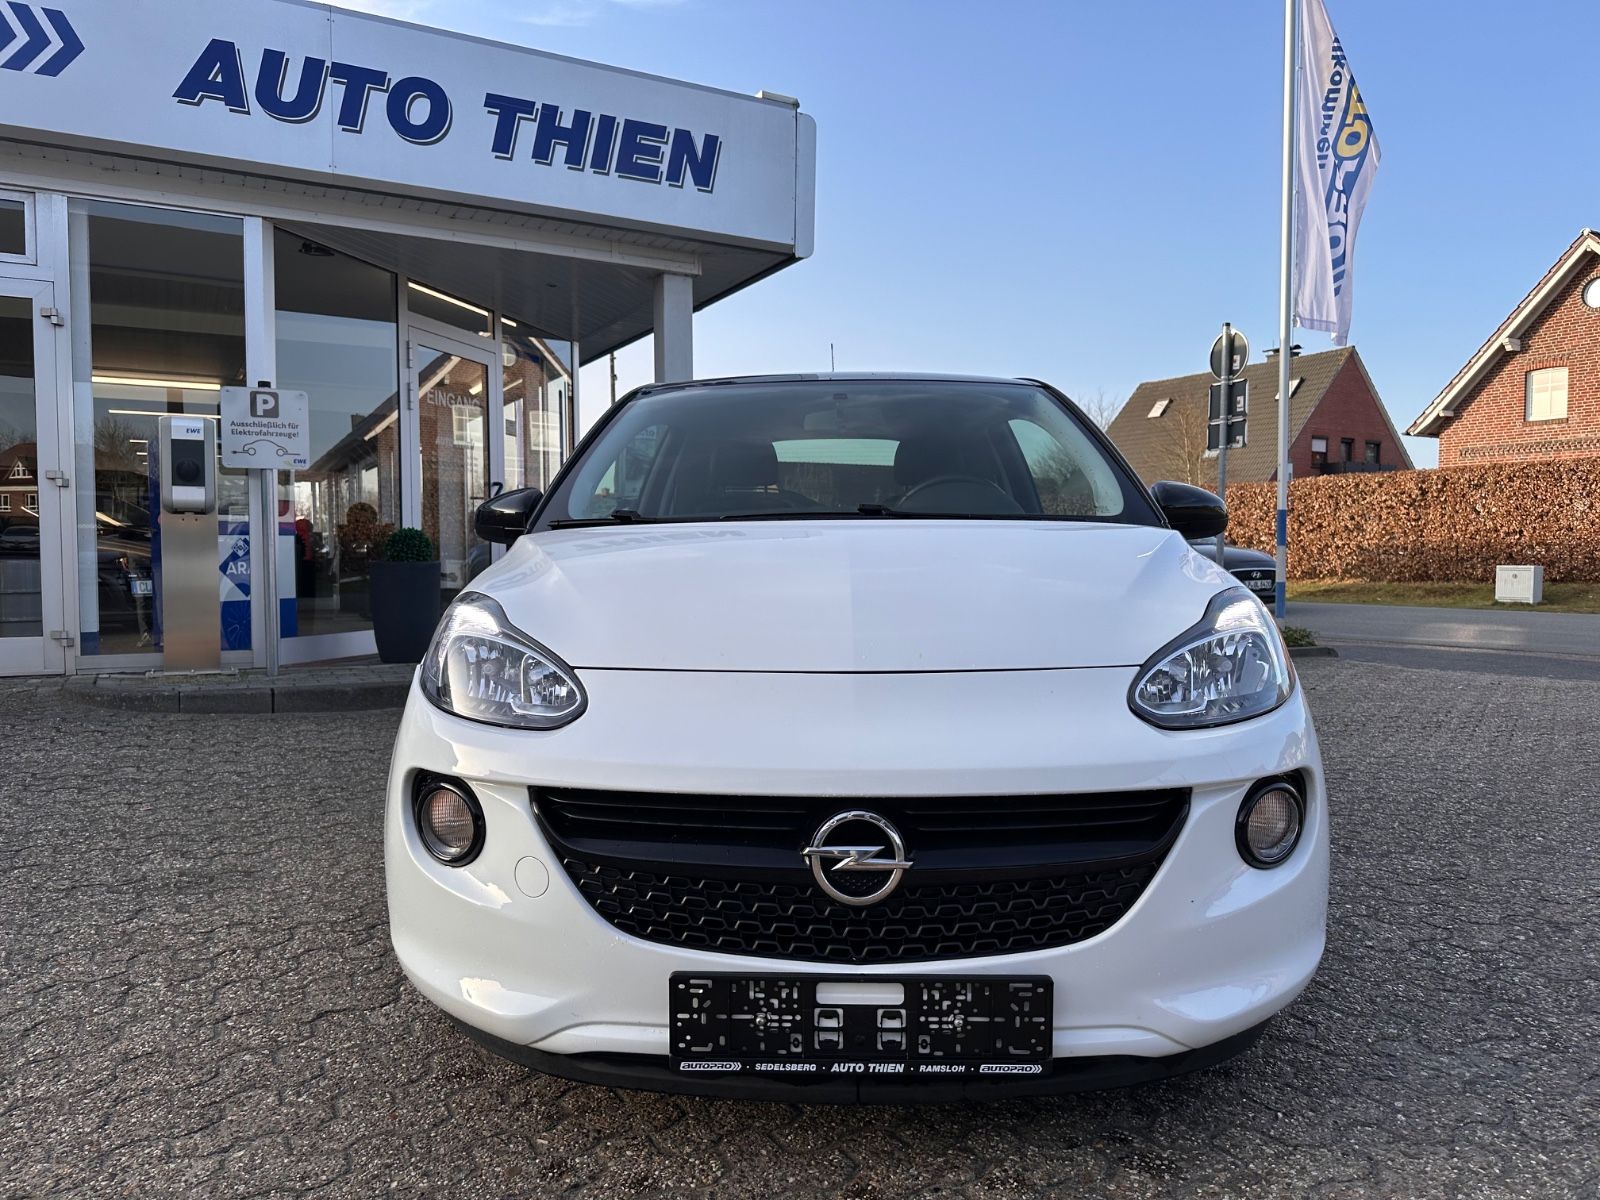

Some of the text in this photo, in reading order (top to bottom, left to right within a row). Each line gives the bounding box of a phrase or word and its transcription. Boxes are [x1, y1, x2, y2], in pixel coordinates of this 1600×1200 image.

[172, 38, 722, 192] AUTO THIEN
[255, 394, 275, 416] P
[230, 420, 300, 430] Ausschließlich für
[231, 429, 300, 439] Elektrofahrzeuge!
[754, 1063, 817, 1072] SEDELSBERG
[831, 1062, 866, 1073] AUTO
[867, 1063, 905, 1073] THIEN
[919, 1064, 966, 1073] RAMSLOH
